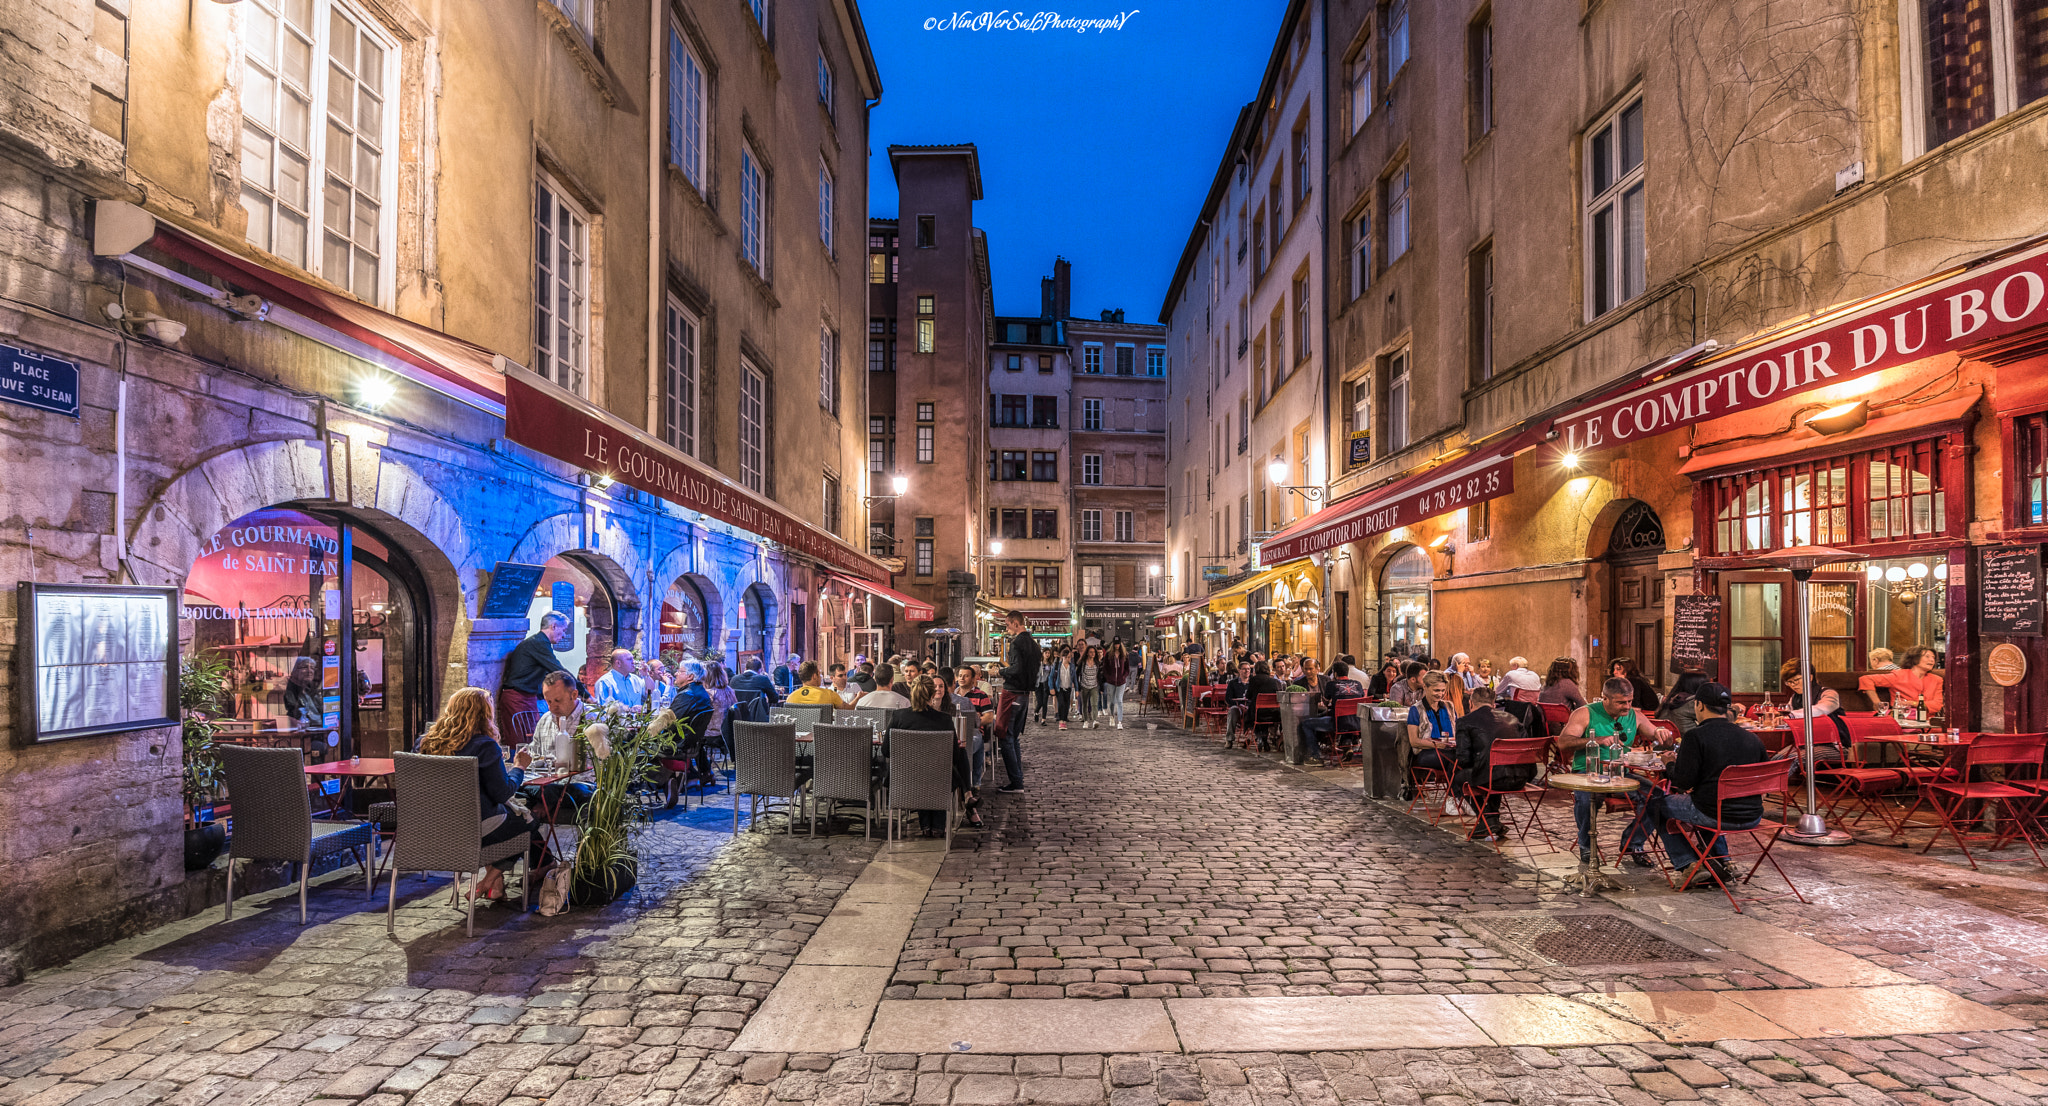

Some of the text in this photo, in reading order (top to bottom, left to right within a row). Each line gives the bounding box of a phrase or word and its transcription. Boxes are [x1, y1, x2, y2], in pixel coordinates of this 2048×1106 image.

[13, 361, 49, 381] PLACE
[1567, 262, 2048, 452] LE COMPTOIR DU BO
[584, 428, 608, 465] LE
[618, 446, 709, 505] GOURMAND
[713, 488, 727, 513] DE
[731, 497, 759, 526] SAINT
[761, 511, 780, 535] JEAN
[1262, 470, 1500, 563] RESTAURANT LE COMPTOIR DU BOEUF 04 78 92 82 35
[200, 525, 339, 558] LE GOURMAND
[222, 553, 338, 576] de SAINT JEAN
[1671, 578, 1677, 590] 3
[185, 606, 314, 620] BOUCHON LYONNAIS
